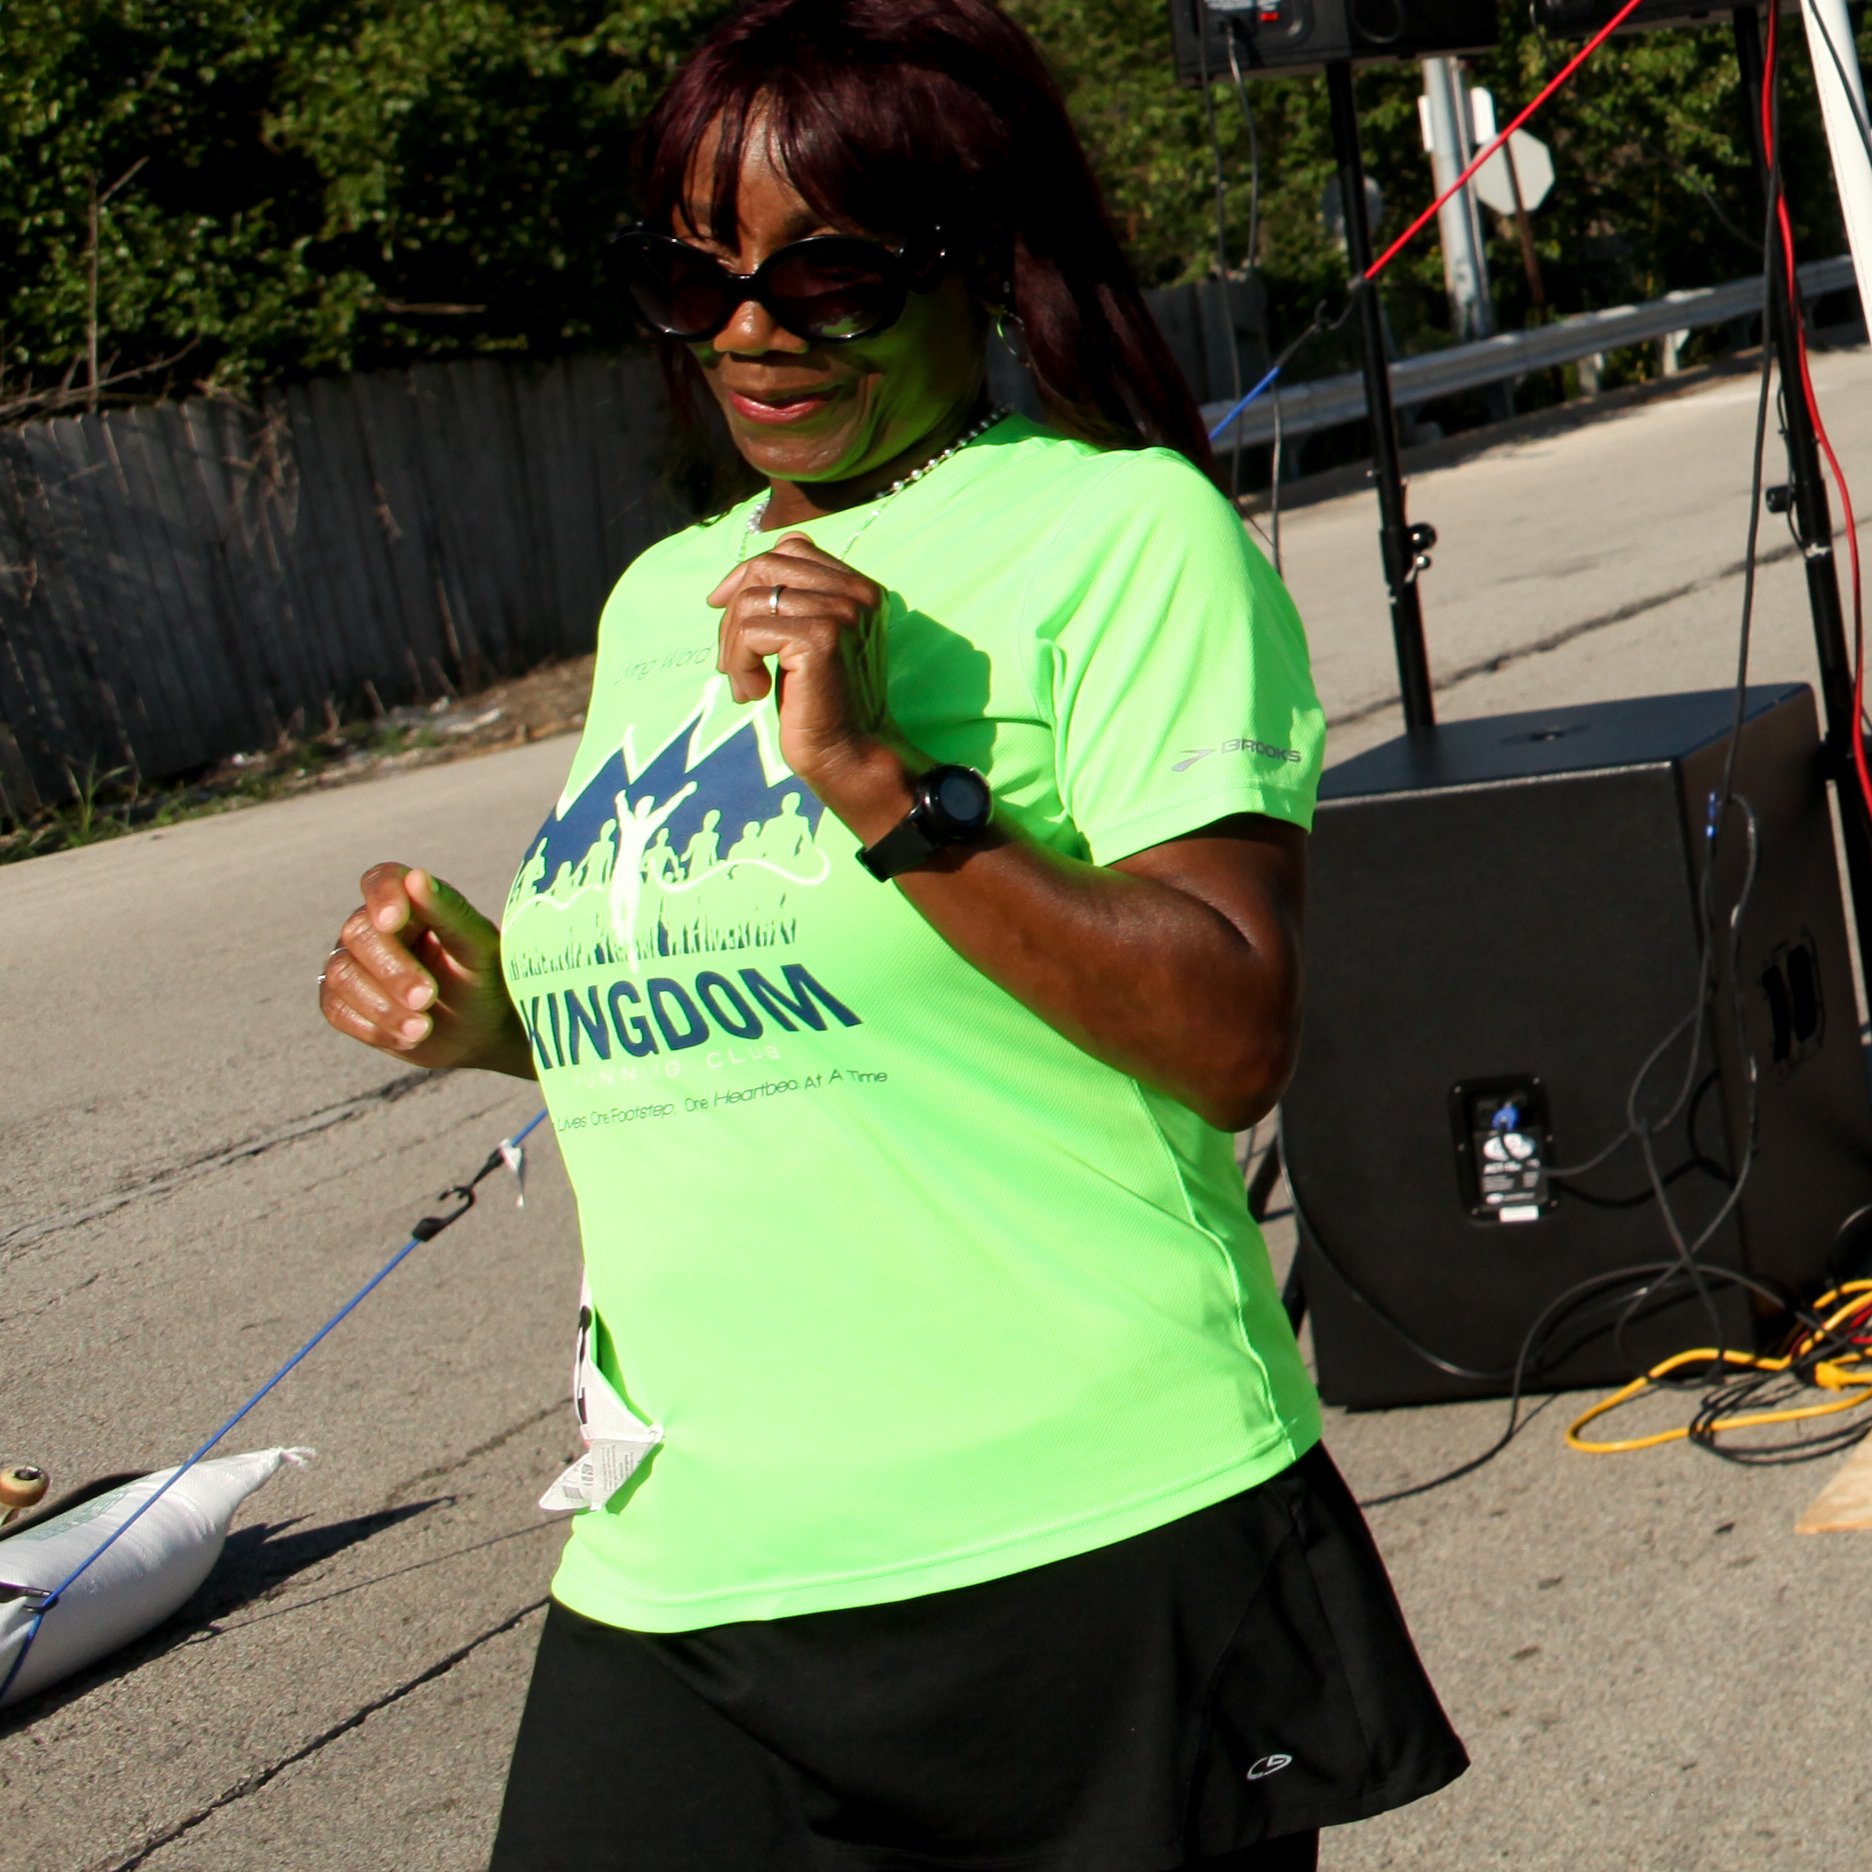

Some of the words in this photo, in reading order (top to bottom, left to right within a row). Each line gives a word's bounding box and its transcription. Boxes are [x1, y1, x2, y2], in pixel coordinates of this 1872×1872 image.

[1221, 738, 1301, 762] BROOKS
[520, 963, 863, 1070] KINGDOM
[707, 1045, 782, 1069] CLUB
[713, 1079, 800, 1109] Heartbea
[803, 1073, 823, 1089] At
[828, 1069, 844, 1084] A
[846, 1069, 888, 1084] Time
